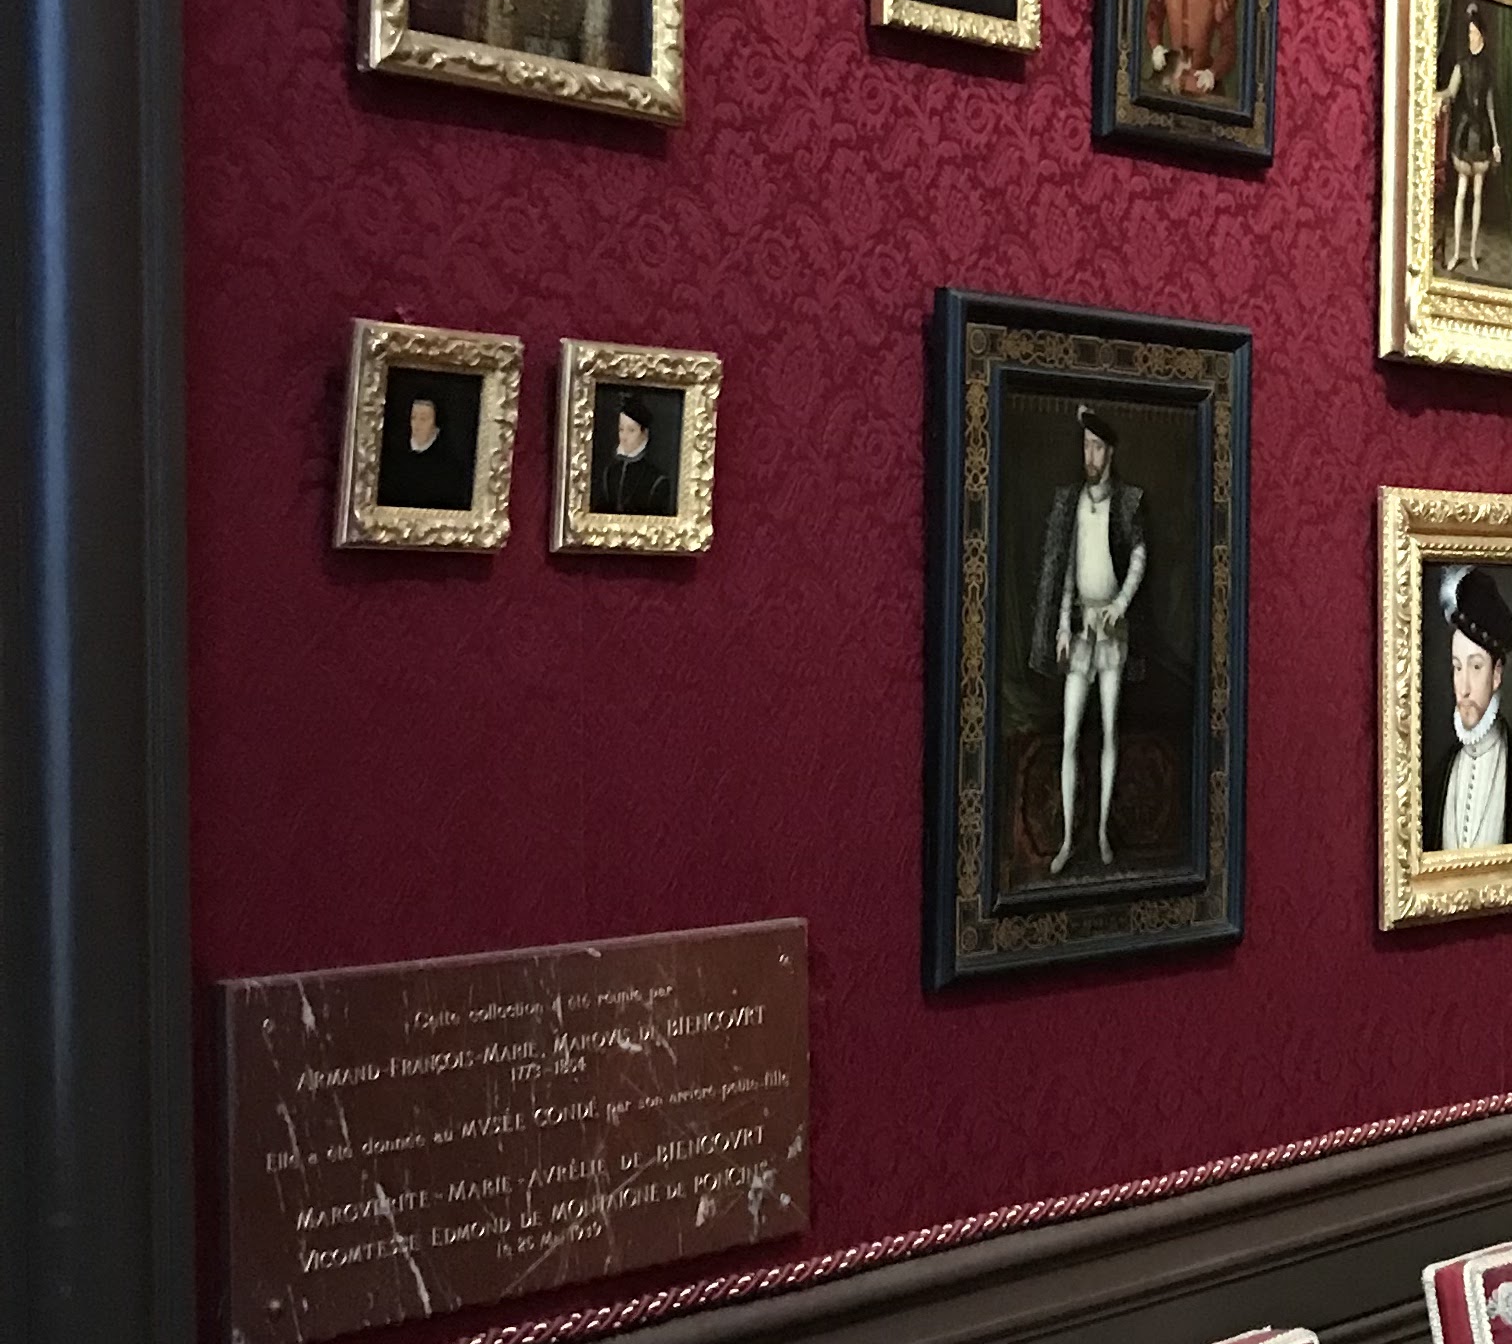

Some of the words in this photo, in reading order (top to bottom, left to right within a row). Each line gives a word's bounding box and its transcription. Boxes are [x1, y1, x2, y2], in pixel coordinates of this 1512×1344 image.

[414, 1009, 460, 1030] Cette
[468, 1001, 544, 1024] collection
[567, 992, 590, 1010] été
[598, 986, 642, 1006] réunie
[649, 985, 673, 1003] par
[667, 1005, 766, 1037] BIENCOVRT
[266, 1150, 299, 1173] Elle
[308, 1152, 318, 1164] a
[327, 1145, 352, 1163] été
[362, 1132, 426, 1156] donnée
[433, 1128, 454, 1143] au
[534, 1095, 599, 1127] CONDÉ
[606, 1099, 632, 1123] par
[638, 1096, 664, 1109] son
[620, 1151, 643, 1171] DE
[656, 1125, 765, 1164] BIENCOVRT
[432, 1216, 512, 1248] EDMOND
[520, 1209, 543, 1230] DE
[552, 1182, 661, 1222] MONTAIGNE
[666, 1181, 688, 1200] DE
